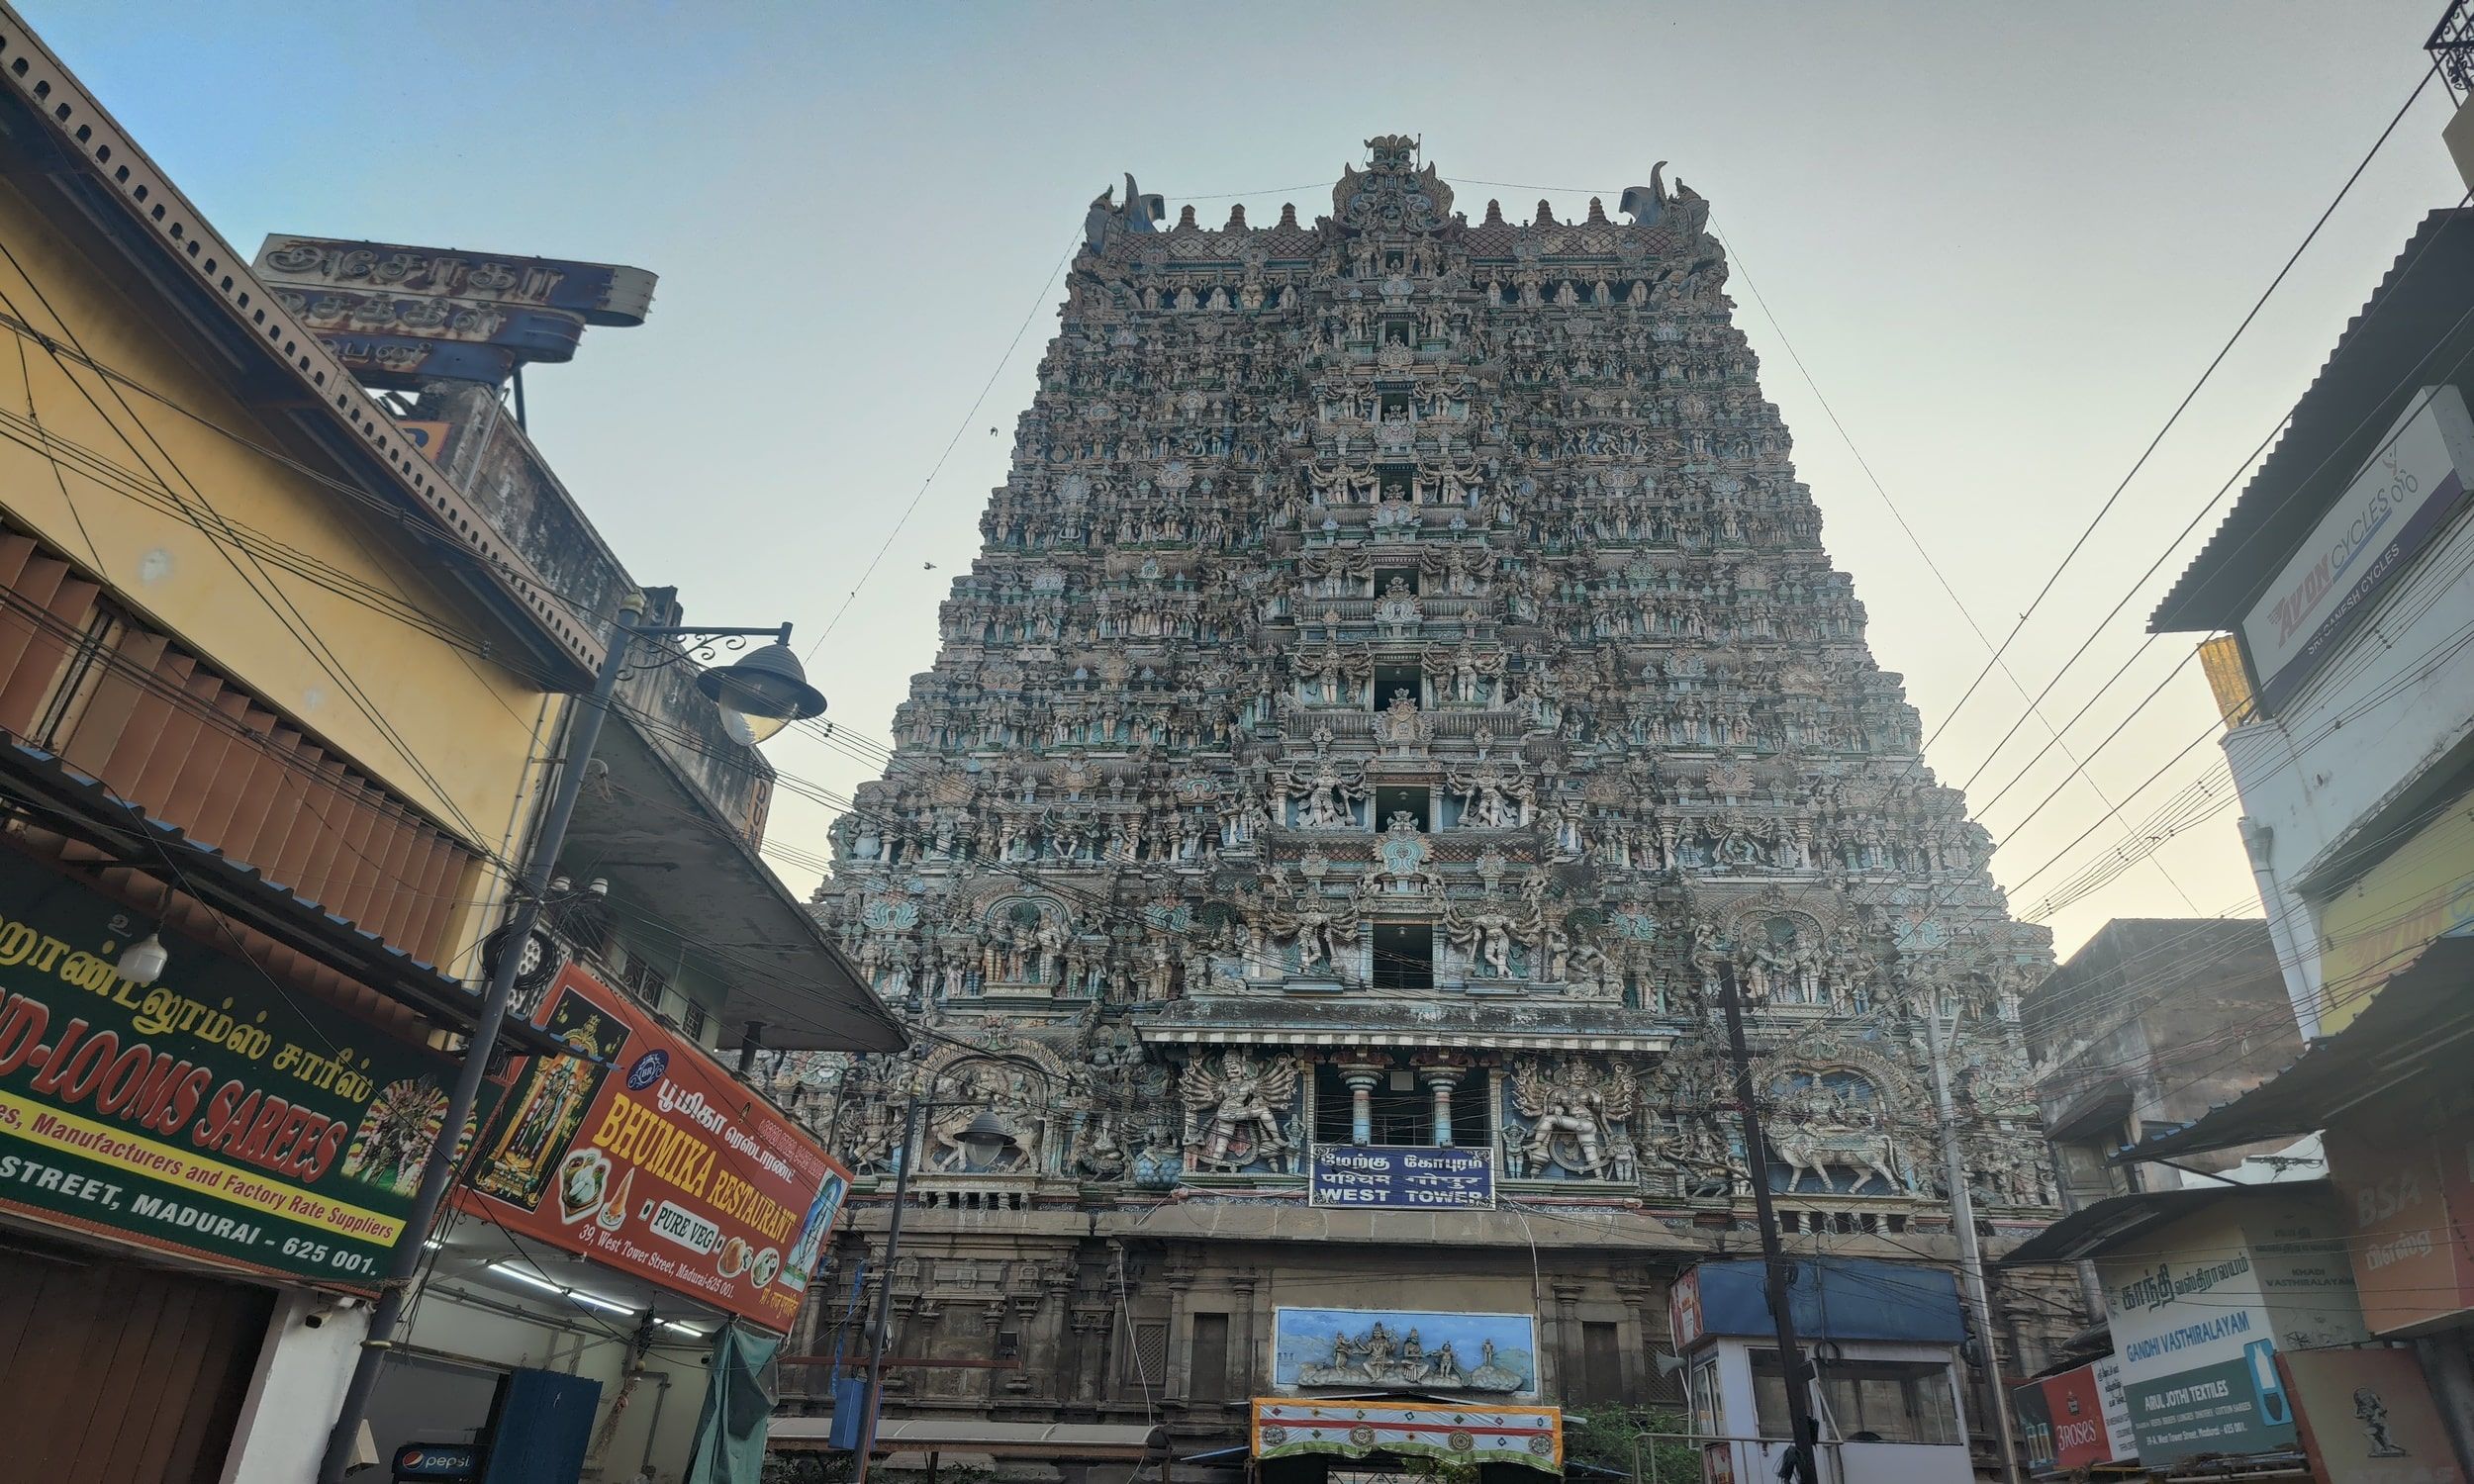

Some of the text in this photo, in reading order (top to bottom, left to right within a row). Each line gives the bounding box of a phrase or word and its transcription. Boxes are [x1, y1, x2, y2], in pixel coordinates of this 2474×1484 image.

[266, 245, 564, 304] அசோகா
[2331, 488, 2390, 570] CYCLES
[2360, 543, 2401, 594] CYCLES
[192, 1078, 348, 1183] SAREES
[656, 1078, 727, 1131] பூமிகா
[31, 1112, 184, 1176] Manufacturers
[186, 1164, 222, 1187] and
[223, 1174, 287, 1210] Factory
[291, 1194, 325, 1221] Rate
[328, 1206, 394, 1239] Suppliers
[593, 1092, 717, 1199] BHUMIKA
[707, 1169, 798, 1244] RESTAURANT
[1321, 1153, 1482, 1172] மேற்கு கோபுரம்
[1321, 1170, 1390, 1186] पश्चिम
[0, 1156, 122, 1211] STREET,
[132, 1194, 259, 1245] MADURAI
[282, 1237, 327, 1263] 625
[332, 1251, 377, 1276] 001.
[1320, 1188, 1482, 1204] WEST TOWER
[2358, 1170, 2423, 1229] BSA
[578, 1223, 595, 1247] 39,
[597, 1233, 621, 1254] West
[622, 1240, 651, 1266] Tower
[649, 1252, 676, 1278] Street,
[653, 1209, 715, 1251] PURE VEG
[2127, 1311, 2250, 1363] GANDHI VASTHIRALAYAM
[2144, 1392, 2166, 1412] ARUL
[2165, 1388, 2191, 1408] JOTHI
[2190, 1379, 2230, 1401] TEXTILES
[425, 1454, 471, 1470] pepsi
